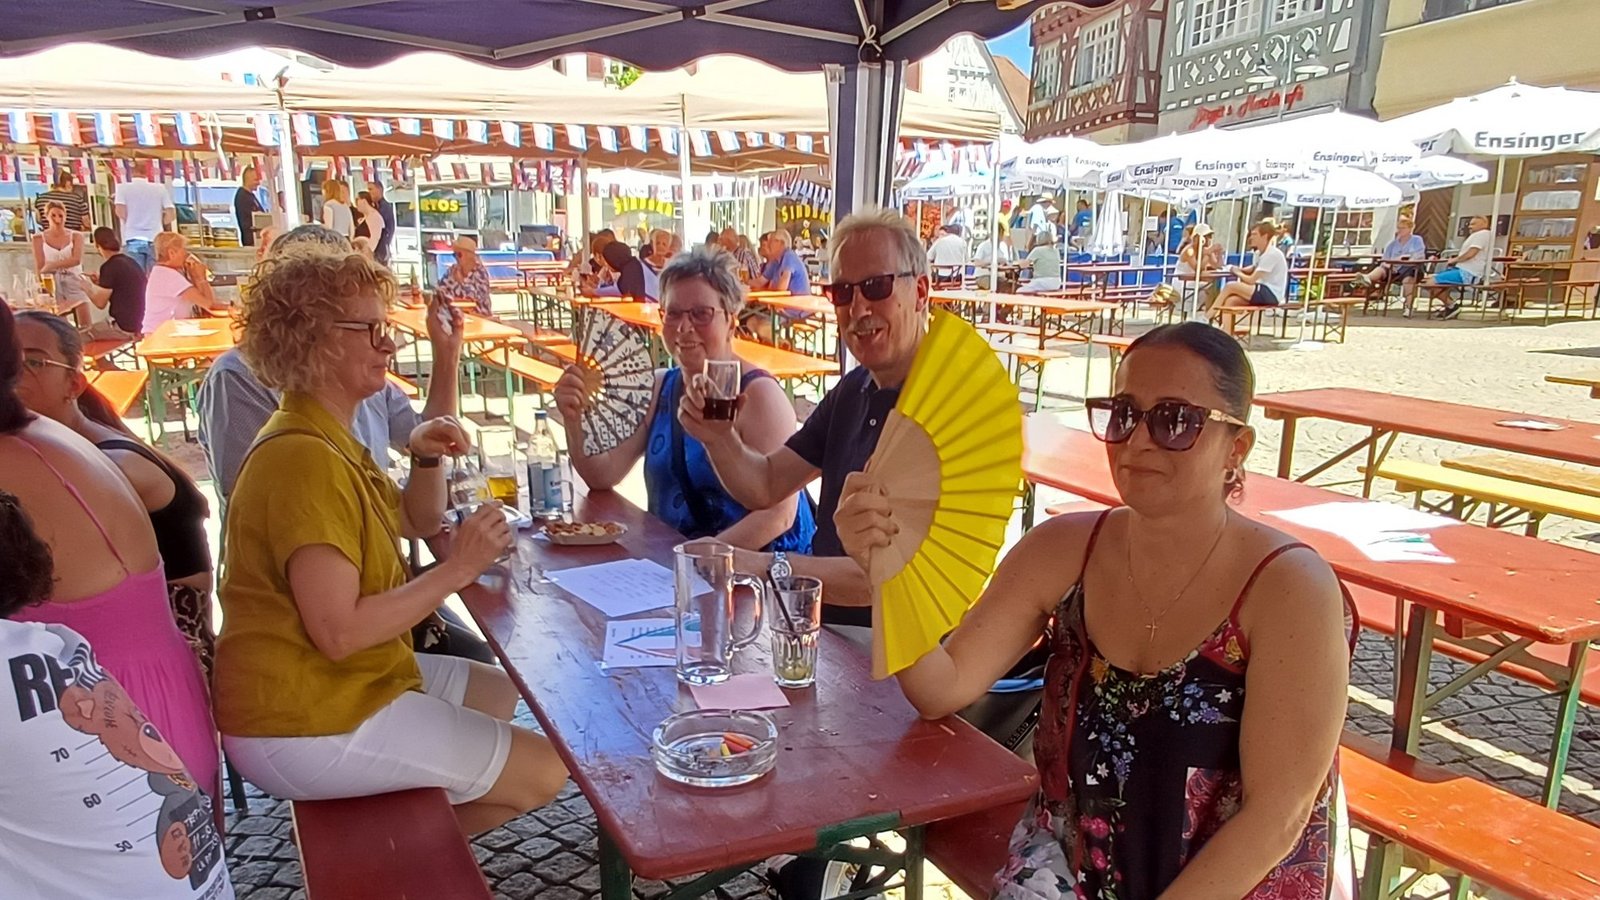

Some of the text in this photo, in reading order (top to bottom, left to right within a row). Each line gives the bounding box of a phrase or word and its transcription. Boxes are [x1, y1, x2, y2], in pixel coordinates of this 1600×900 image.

[1475, 131, 1586, 151] Ensinger
[1313, 151, 1363, 164] Ensinger
[1134, 164, 1174, 176] Ensinger
[1195, 160, 1247, 171] Ensinger
[51, 747, 70, 763] 70
[83, 793, 102, 809] 60
[115, 840, 134, 853] 50
